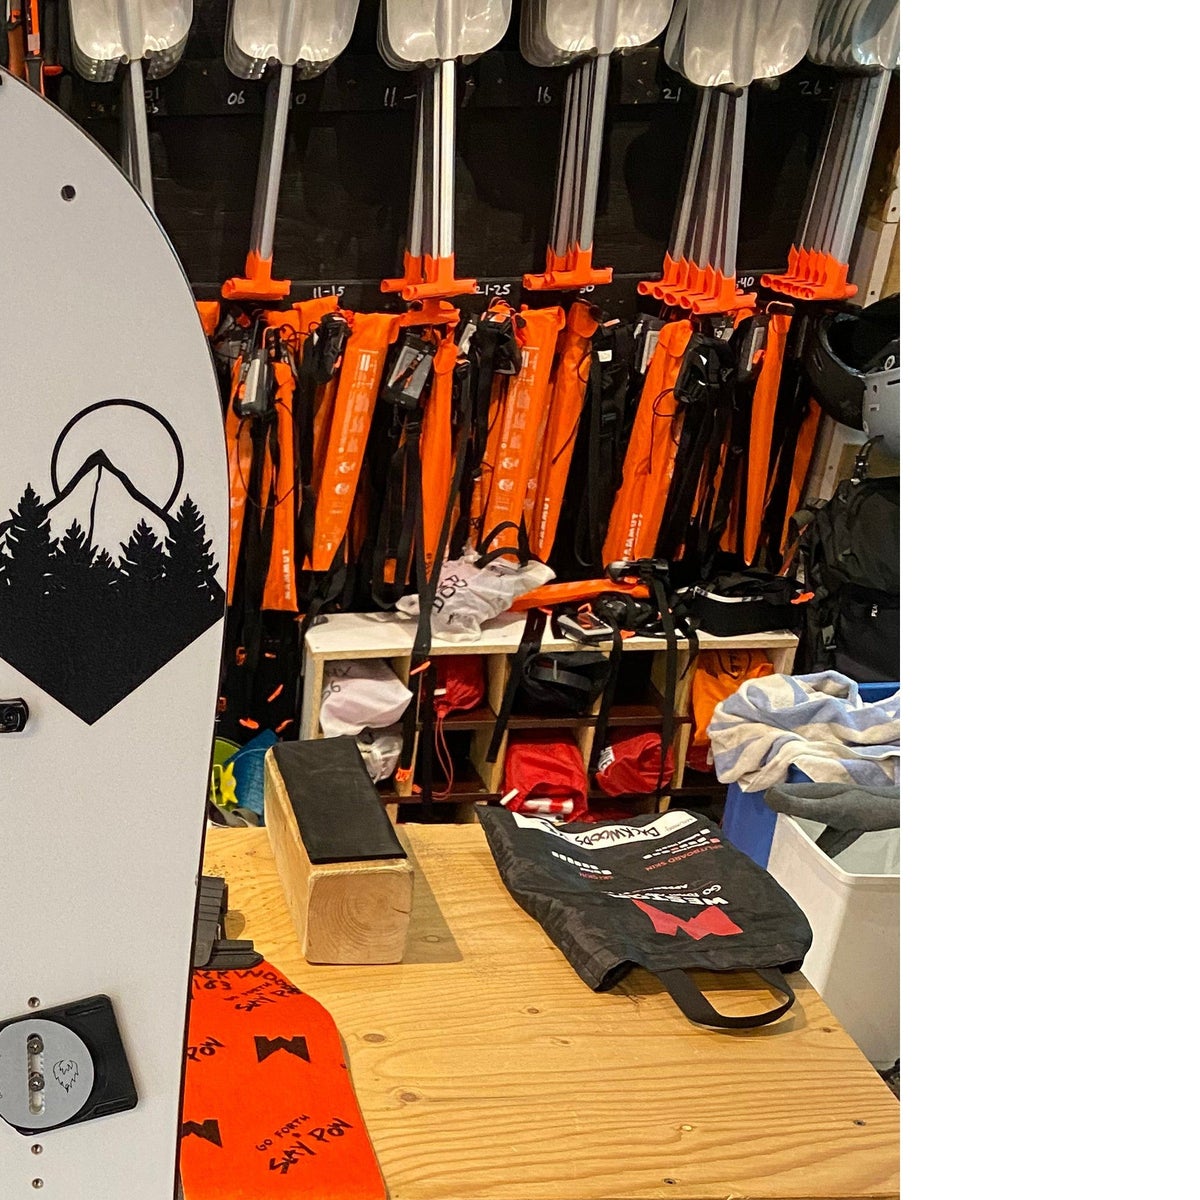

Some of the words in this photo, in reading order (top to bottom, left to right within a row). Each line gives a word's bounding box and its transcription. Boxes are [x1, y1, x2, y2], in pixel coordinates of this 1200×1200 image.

[538, 86, 552, 103] 16
[664, 86, 681, 102] 21
[799, 80, 821, 95] 26
[228, 90, 245, 105] 06
[313, 285, 345, 297] 11-15
[282, 549, 292, 600] MAMMUT
[575, 826, 660, 846] BACKWOODS
[256, 1136, 274, 1152] GO
[274, 1114, 310, 1139] FORTH
[269, 1141, 316, 1174] SLAY
[308, 1117, 354, 1144] POW
